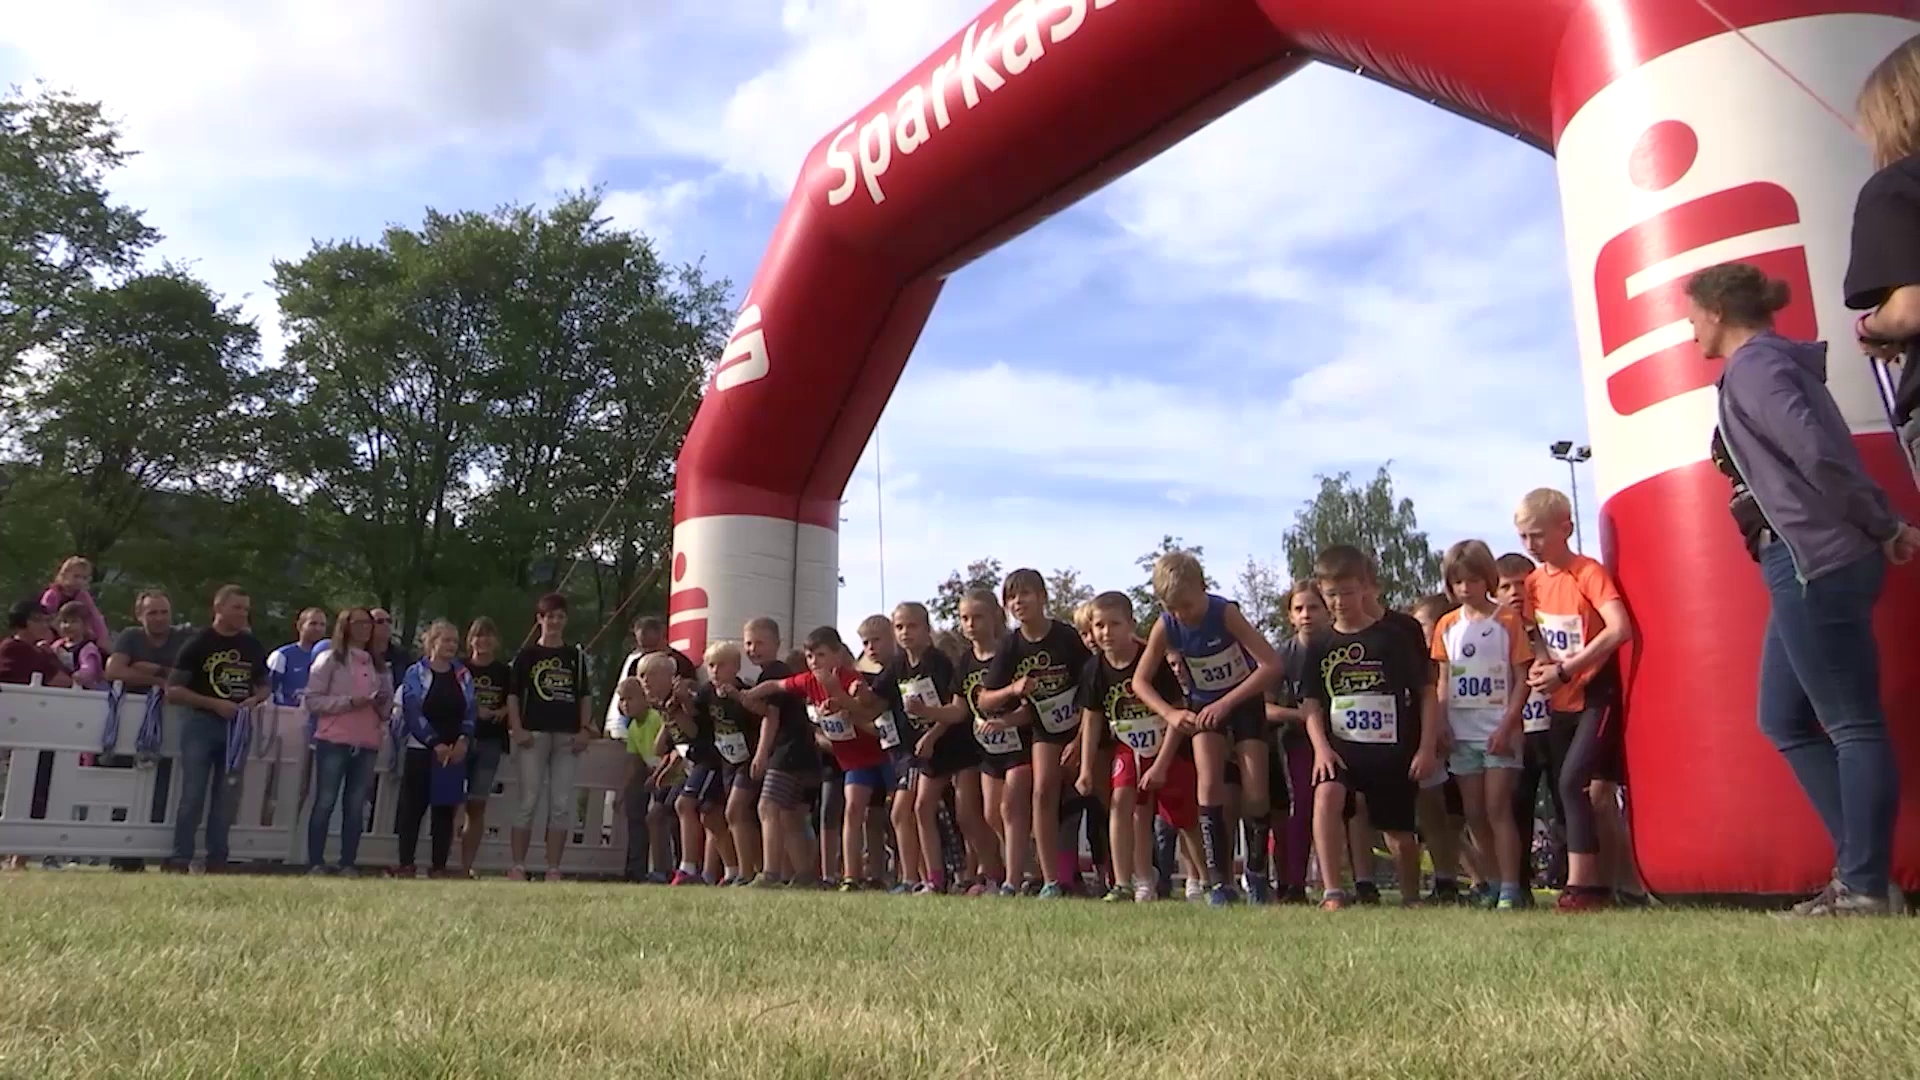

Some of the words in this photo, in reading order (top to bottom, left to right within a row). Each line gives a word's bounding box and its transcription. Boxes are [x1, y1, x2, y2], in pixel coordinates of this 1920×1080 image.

[826, 0, 1117, 206] Sparkas
[1201, 662, 1233, 682] 337
[1458, 677, 1491, 696] 304
[1346, 710, 1382, 730] 333
[1128, 730, 1156, 748] 327
